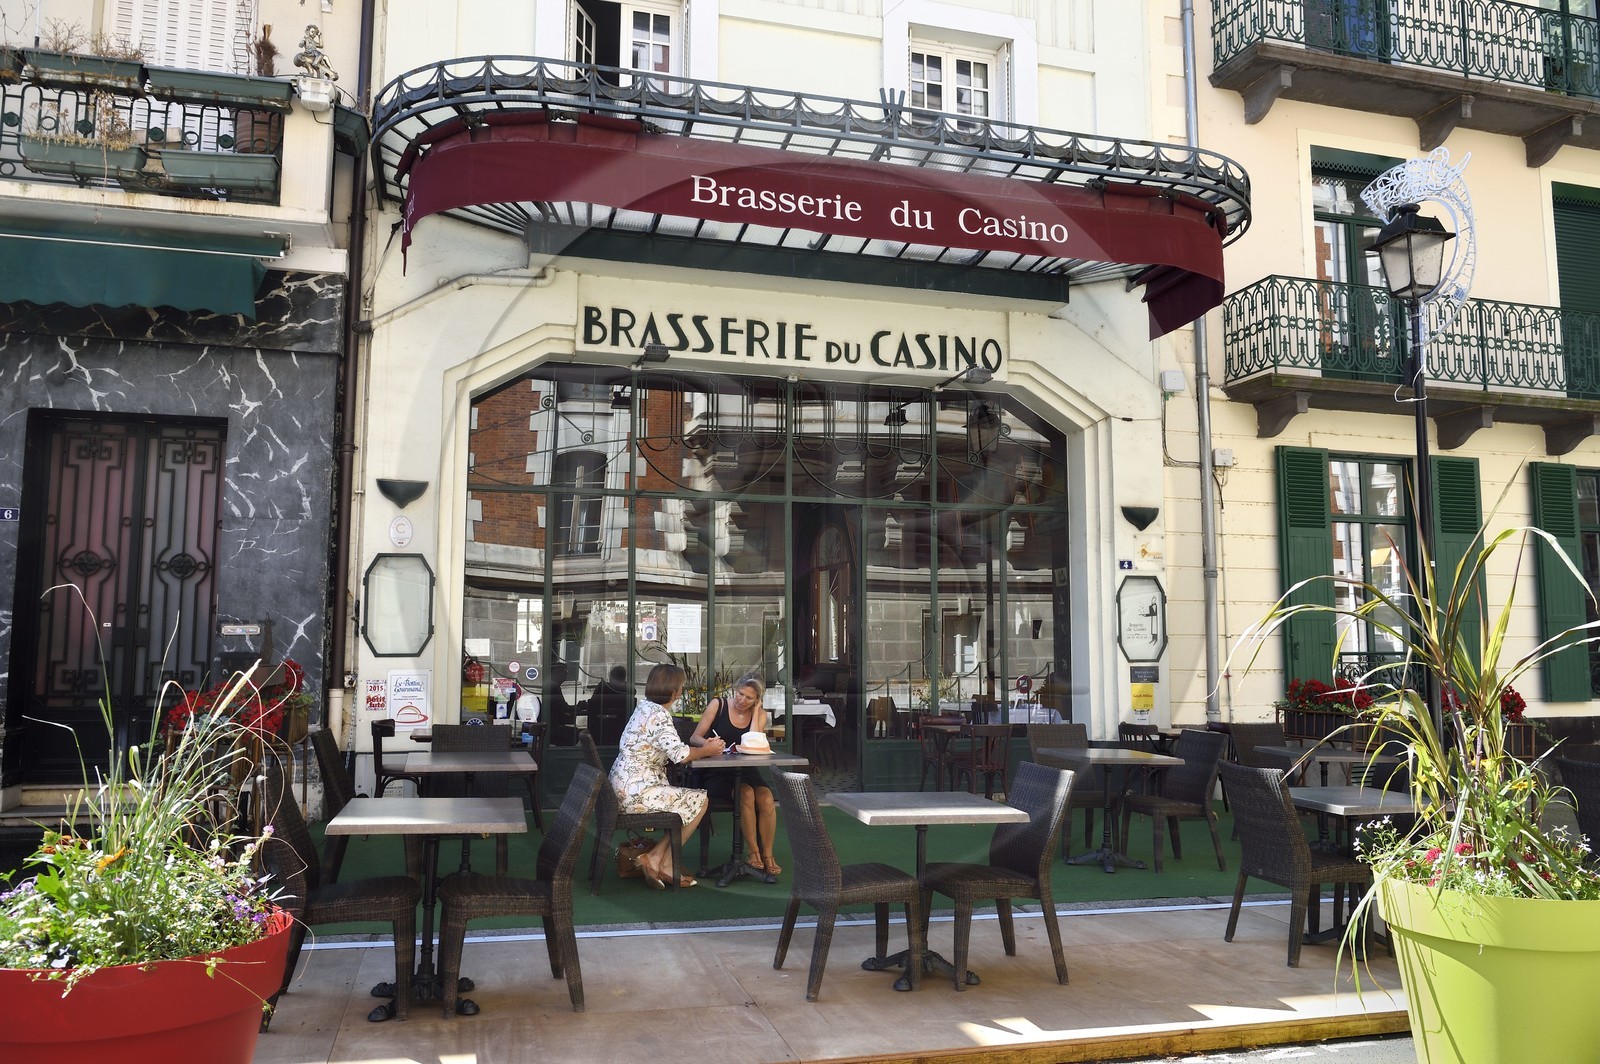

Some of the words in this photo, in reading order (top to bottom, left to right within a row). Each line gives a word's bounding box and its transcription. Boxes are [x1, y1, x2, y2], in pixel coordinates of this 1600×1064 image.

[691, 174, 863, 222] Brasserie
[890, 200, 935, 231] du
[958, 207, 1069, 244] Casino
[583, 305, 818, 361] BRASSERIE
[825, 341, 861, 364] DU
[870, 330, 1003, 374] CASINO
[4, 509, 12, 520] 6
[1123, 561, 1129, 569] 4
[366, 694, 386, 704] petit
